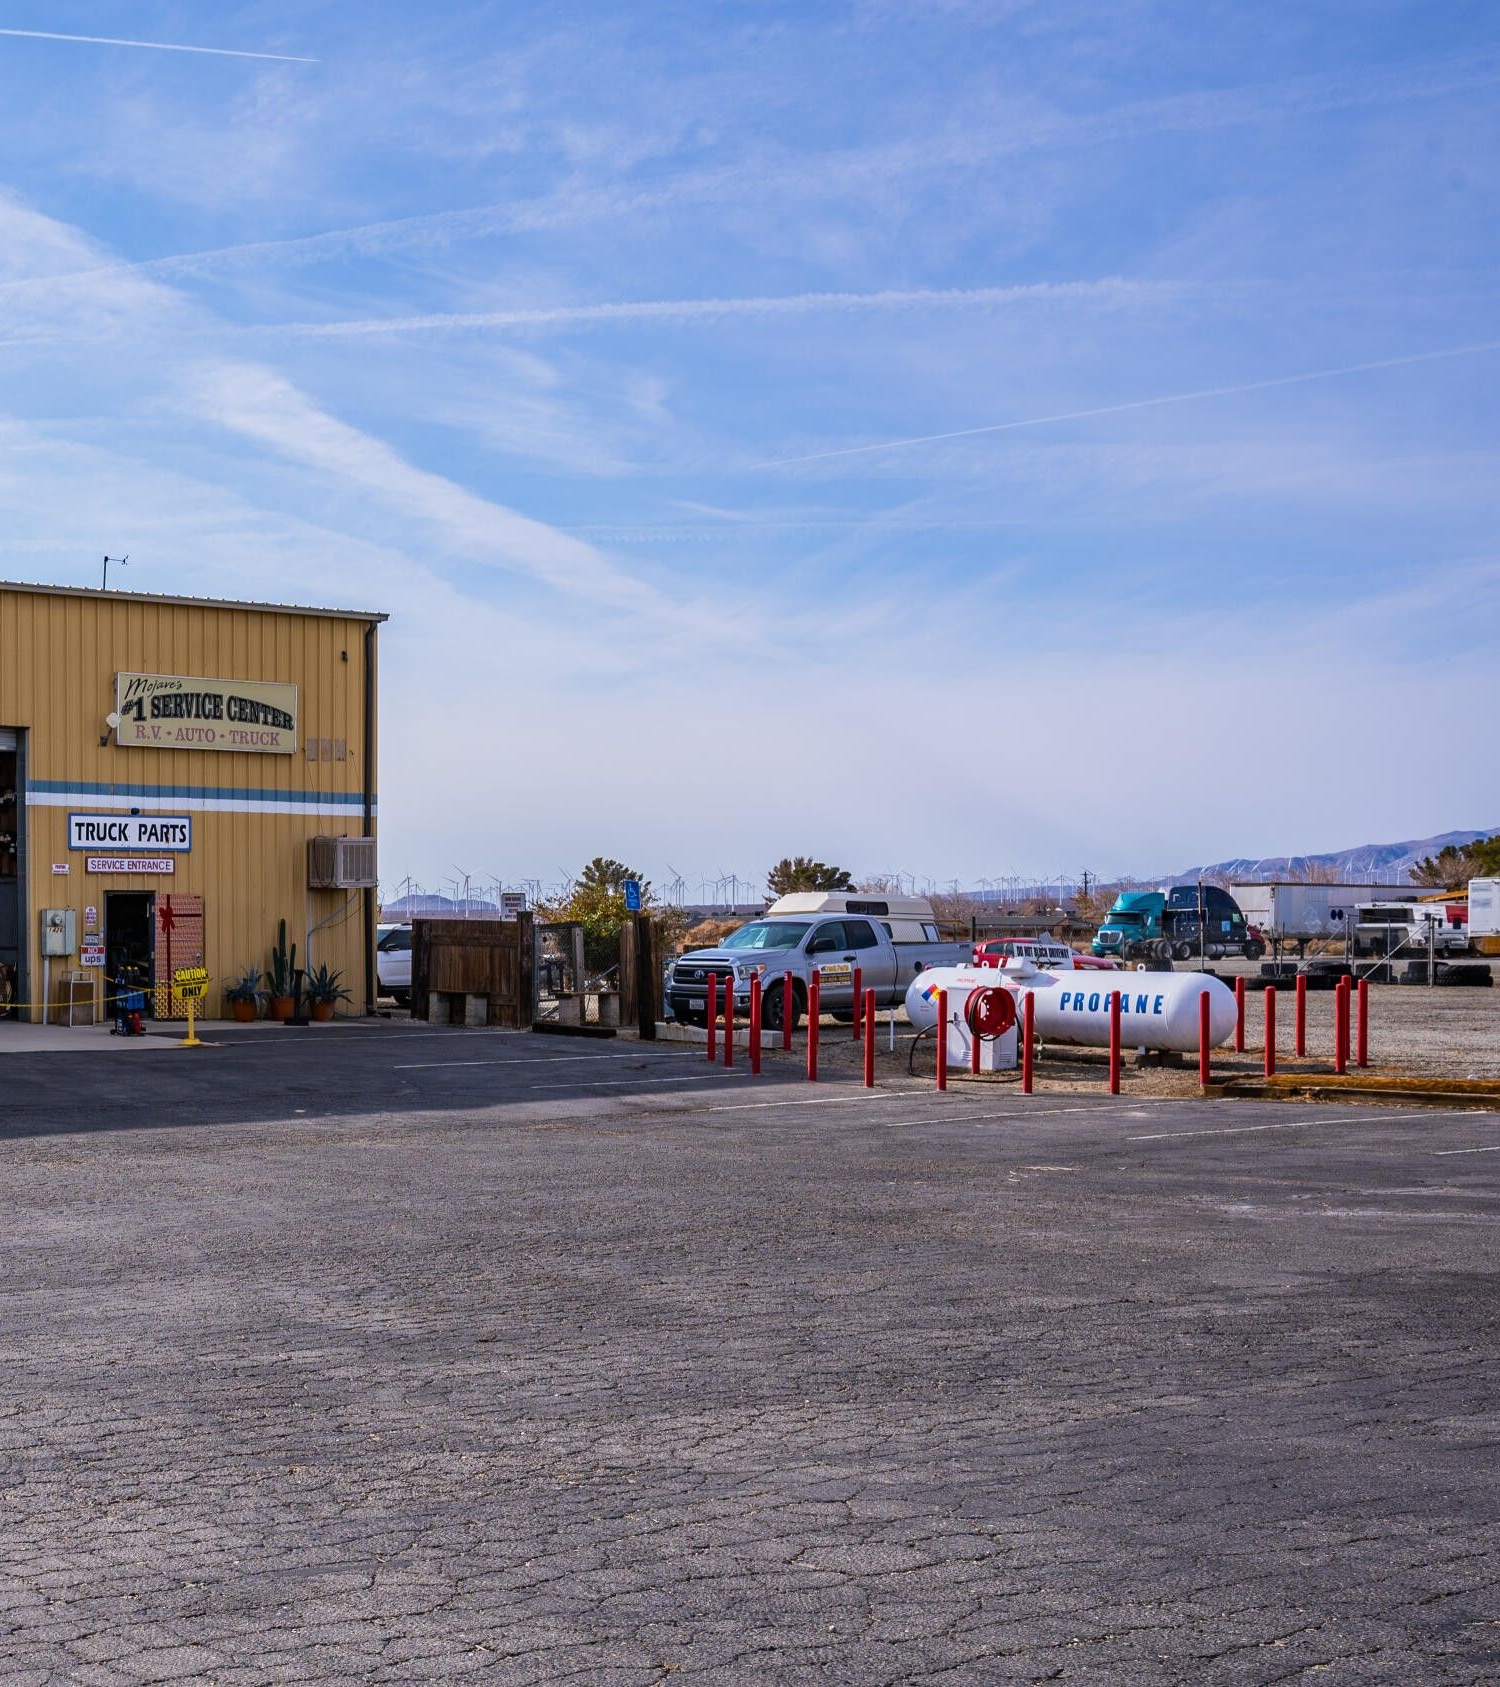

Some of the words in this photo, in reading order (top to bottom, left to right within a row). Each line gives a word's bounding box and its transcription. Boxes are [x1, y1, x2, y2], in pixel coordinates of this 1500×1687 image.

[124, 678, 182, 699] Mojave's
[120, 696, 147, 722] #1
[150, 692, 224, 721] SERVICE
[226, 695, 294, 731] CENTER
[135, 724, 162, 740] R.V.
[175, 727, 216, 743] AUTO
[229, 730, 281, 746] TRUCK
[75, 822, 129, 842] TRUCK
[138, 823, 187, 843] PARTS
[90, 860, 125, 870] SERVICE
[127, 860, 171, 871] ENTRANCE
[88, 946, 99, 954] NO
[85, 955, 102, 964] ups
[175, 967, 206, 981] CAUTION
[181, 985, 202, 998] ONLY
[1059, 991, 1164, 1015] PROPANE
